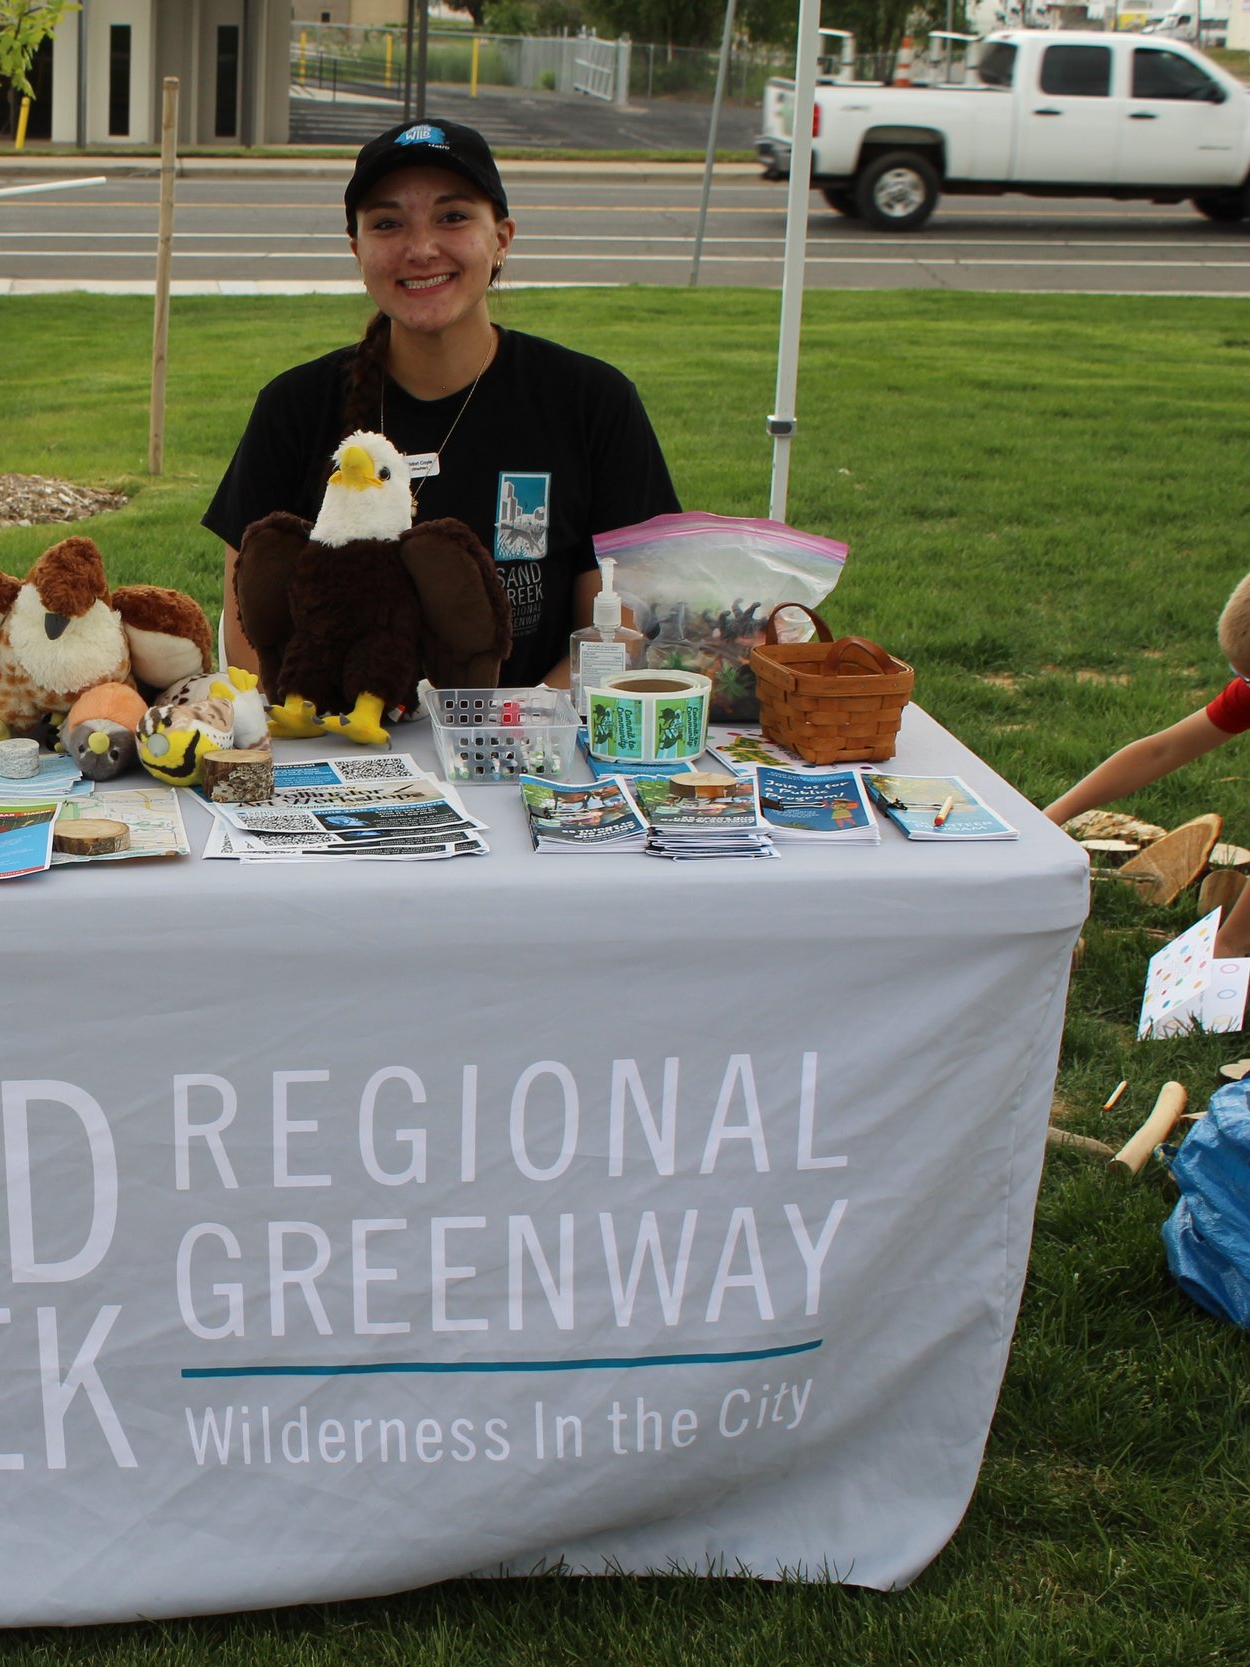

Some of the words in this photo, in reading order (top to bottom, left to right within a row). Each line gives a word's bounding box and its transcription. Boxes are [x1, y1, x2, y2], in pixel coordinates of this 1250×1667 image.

[405, 130, 431, 140] WILD
[495, 562, 541, 588] SAND
[507, 583, 543, 606] REEK
[511, 603, 541, 617] GIONAL
[625, 709, 635, 738] Commit
[764, 780, 797, 789] Join
[825, 781, 849, 789] for
[284, 792, 425, 805] Workshops
[765, 792, 845, 801] Program!
[172, 1051, 849, 1190] REGIONAL
[176, 1199, 848, 1340] GREENWAY
[185, 1406, 510, 1466] Wilderness
[535, 1401, 583, 1460] In
[607, 1397, 698, 1455] the
[719, 1379, 813, 1440] City
